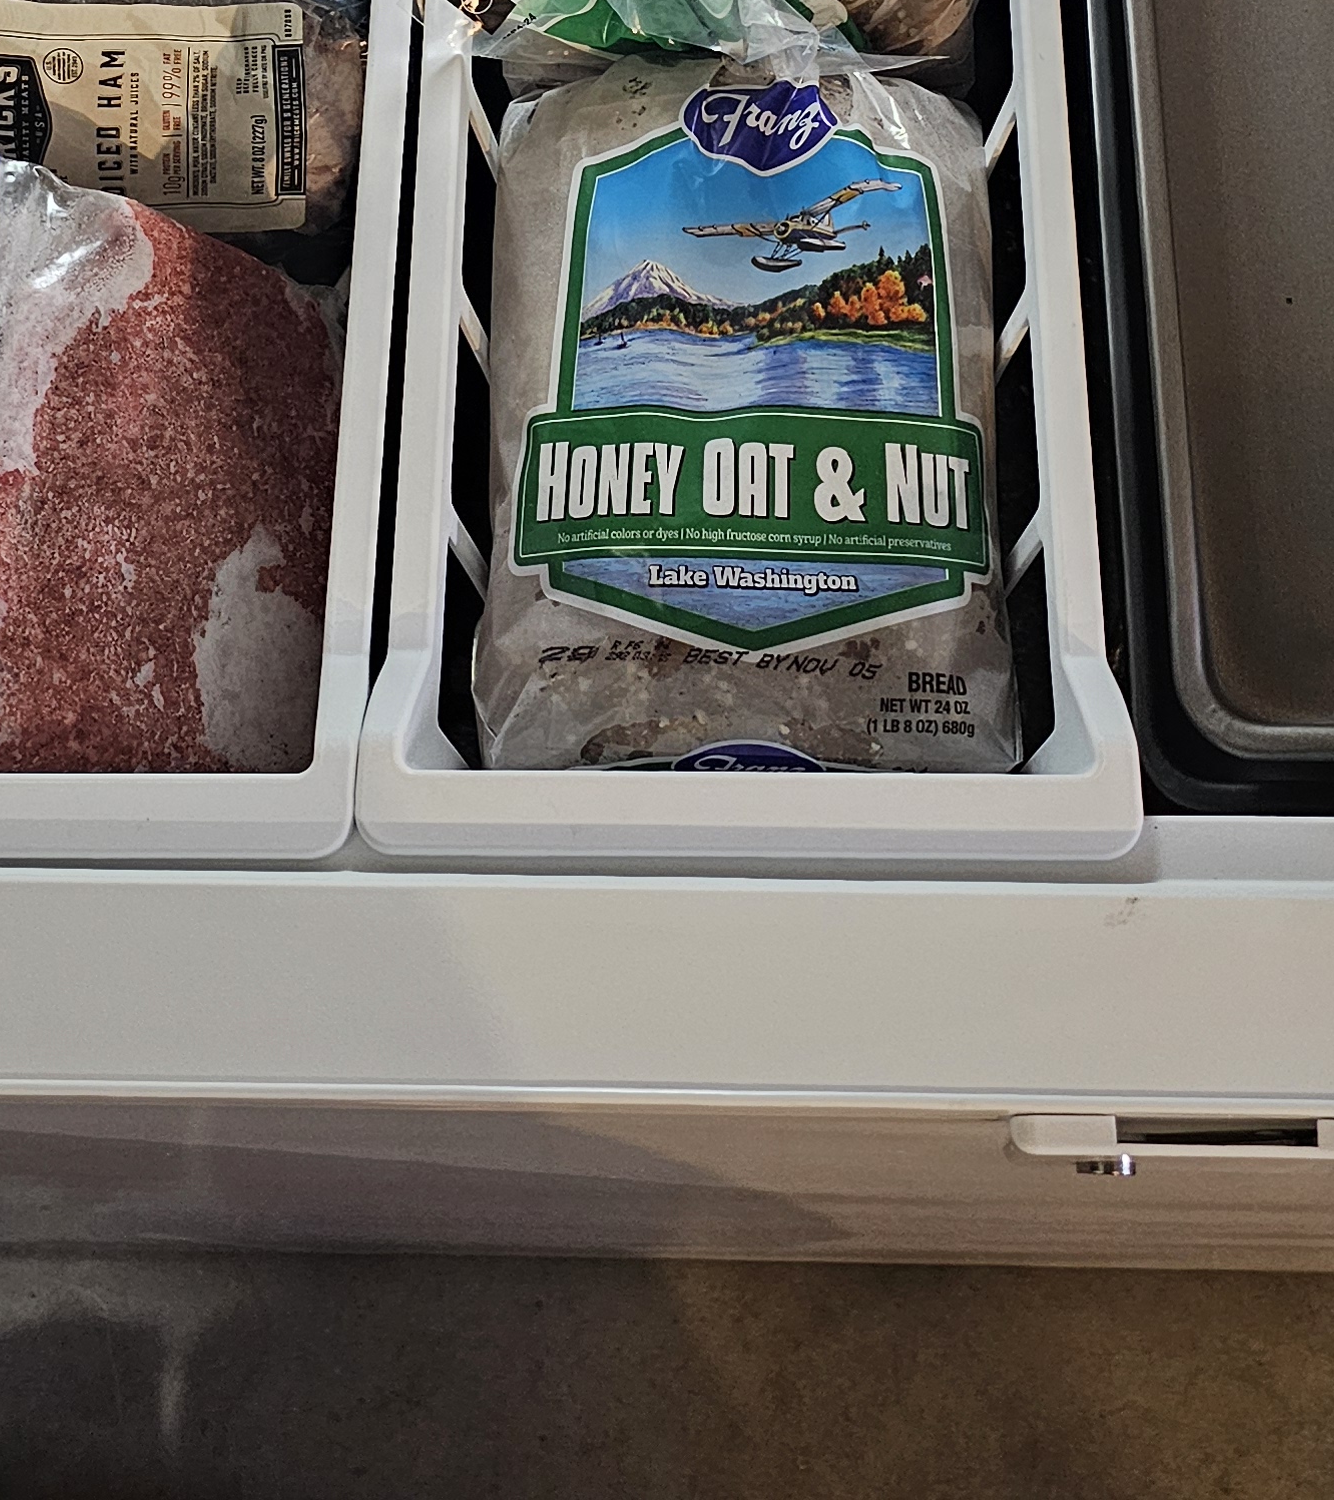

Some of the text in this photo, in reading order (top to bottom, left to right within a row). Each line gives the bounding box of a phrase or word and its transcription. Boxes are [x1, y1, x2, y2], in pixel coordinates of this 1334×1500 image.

[163, 52, 171, 65] FAT
[173, 49, 181, 65] FREE
[162, 67, 181, 99] 99%
[193, 74, 200, 83] 2%
[280, 56, 291, 110] GENERATIONS
[21, 76, 29, 114] MEATS
[96, 50, 126, 195] DICED HAM
[130, 72, 139, 175] WITH NATURAL JUICES
[173, 116, 181, 131] FREE
[250, 115, 267, 145] (227g)
[702, 93, 820, 150] Franz
[173, 140, 181, 175] PER SERVING
[251, 145, 265, 156] OZ
[251, 164, 265, 179] WT.
[163, 176, 185, 196] 10g
[251, 180, 264, 195] NET
[536, 437, 970, 530] HONEY OAT & NUT
[558, 529, 952, 551] No artificial colors or dyes No high fructose corn syrup No artificial preservatives
[649, 565, 858, 595] Lake Washington
[682, 646, 749, 666] BEST
[848, 662, 882, 680] 05
[908, 672, 967, 696] BREAD
[880, 698, 971, 715] NET WT 24 OZ
[867, 718, 975, 738] (1 LB 8 OZ) 680g
